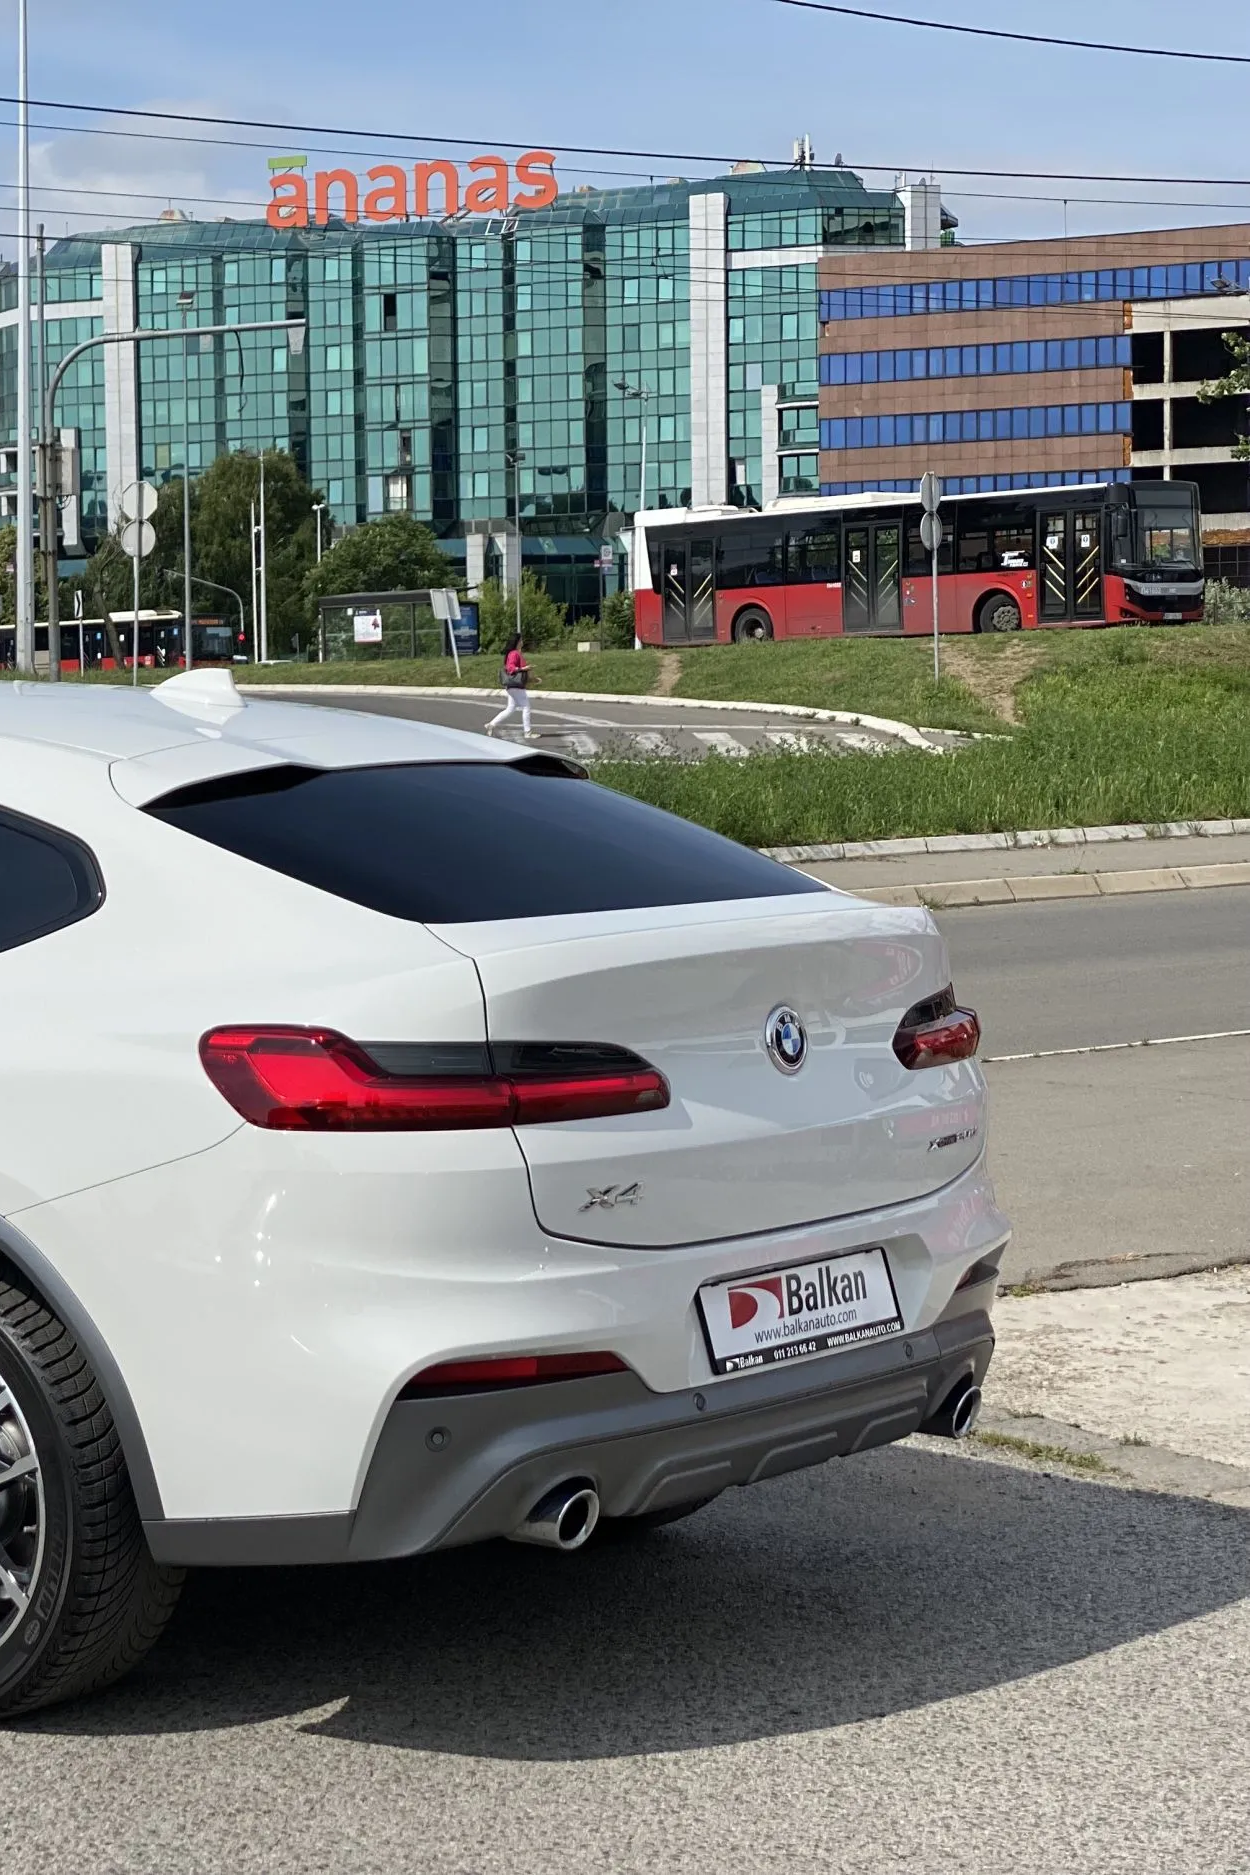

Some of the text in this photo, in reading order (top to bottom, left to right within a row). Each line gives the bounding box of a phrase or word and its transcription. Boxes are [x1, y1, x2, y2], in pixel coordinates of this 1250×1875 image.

[577, 1180, 645, 1213] X4
[785, 1265, 867, 1317] Balkan
[739, 1354, 764, 1369] Balkan
[773, 1349, 785, 1361] 011
[787, 1345, 800, 1357] 213
[808, 1341, 817, 1352] 42
[827, 1320, 901, 1348] WWW.BALKANAUTO.COM
[754, 1308, 858, 1344] www.balkanauto.com
